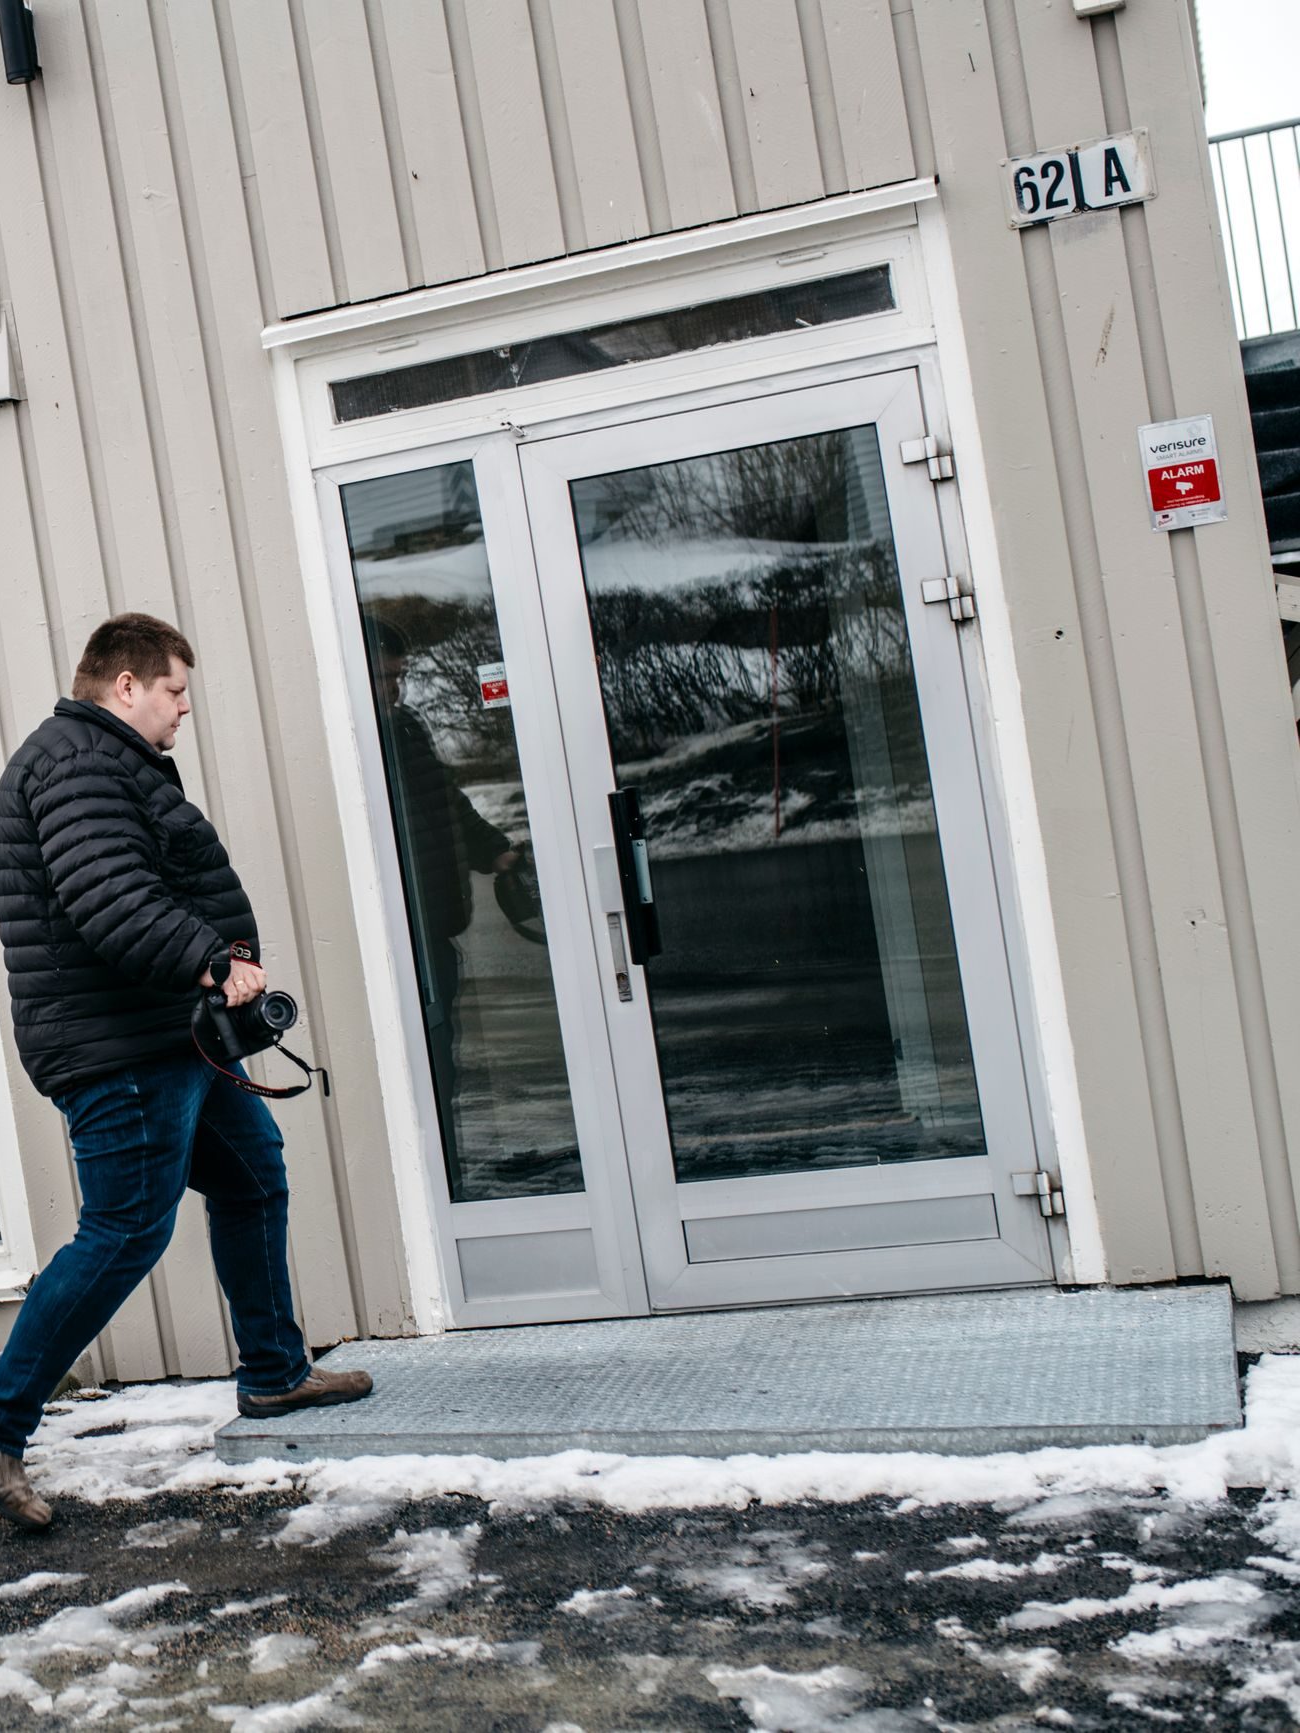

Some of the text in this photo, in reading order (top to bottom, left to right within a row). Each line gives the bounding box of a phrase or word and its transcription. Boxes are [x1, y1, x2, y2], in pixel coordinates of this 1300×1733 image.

[1013, 147, 1131, 214] 62 A
[1150, 437, 1206, 453] verisure
[1161, 464, 1204, 480] ALARM
